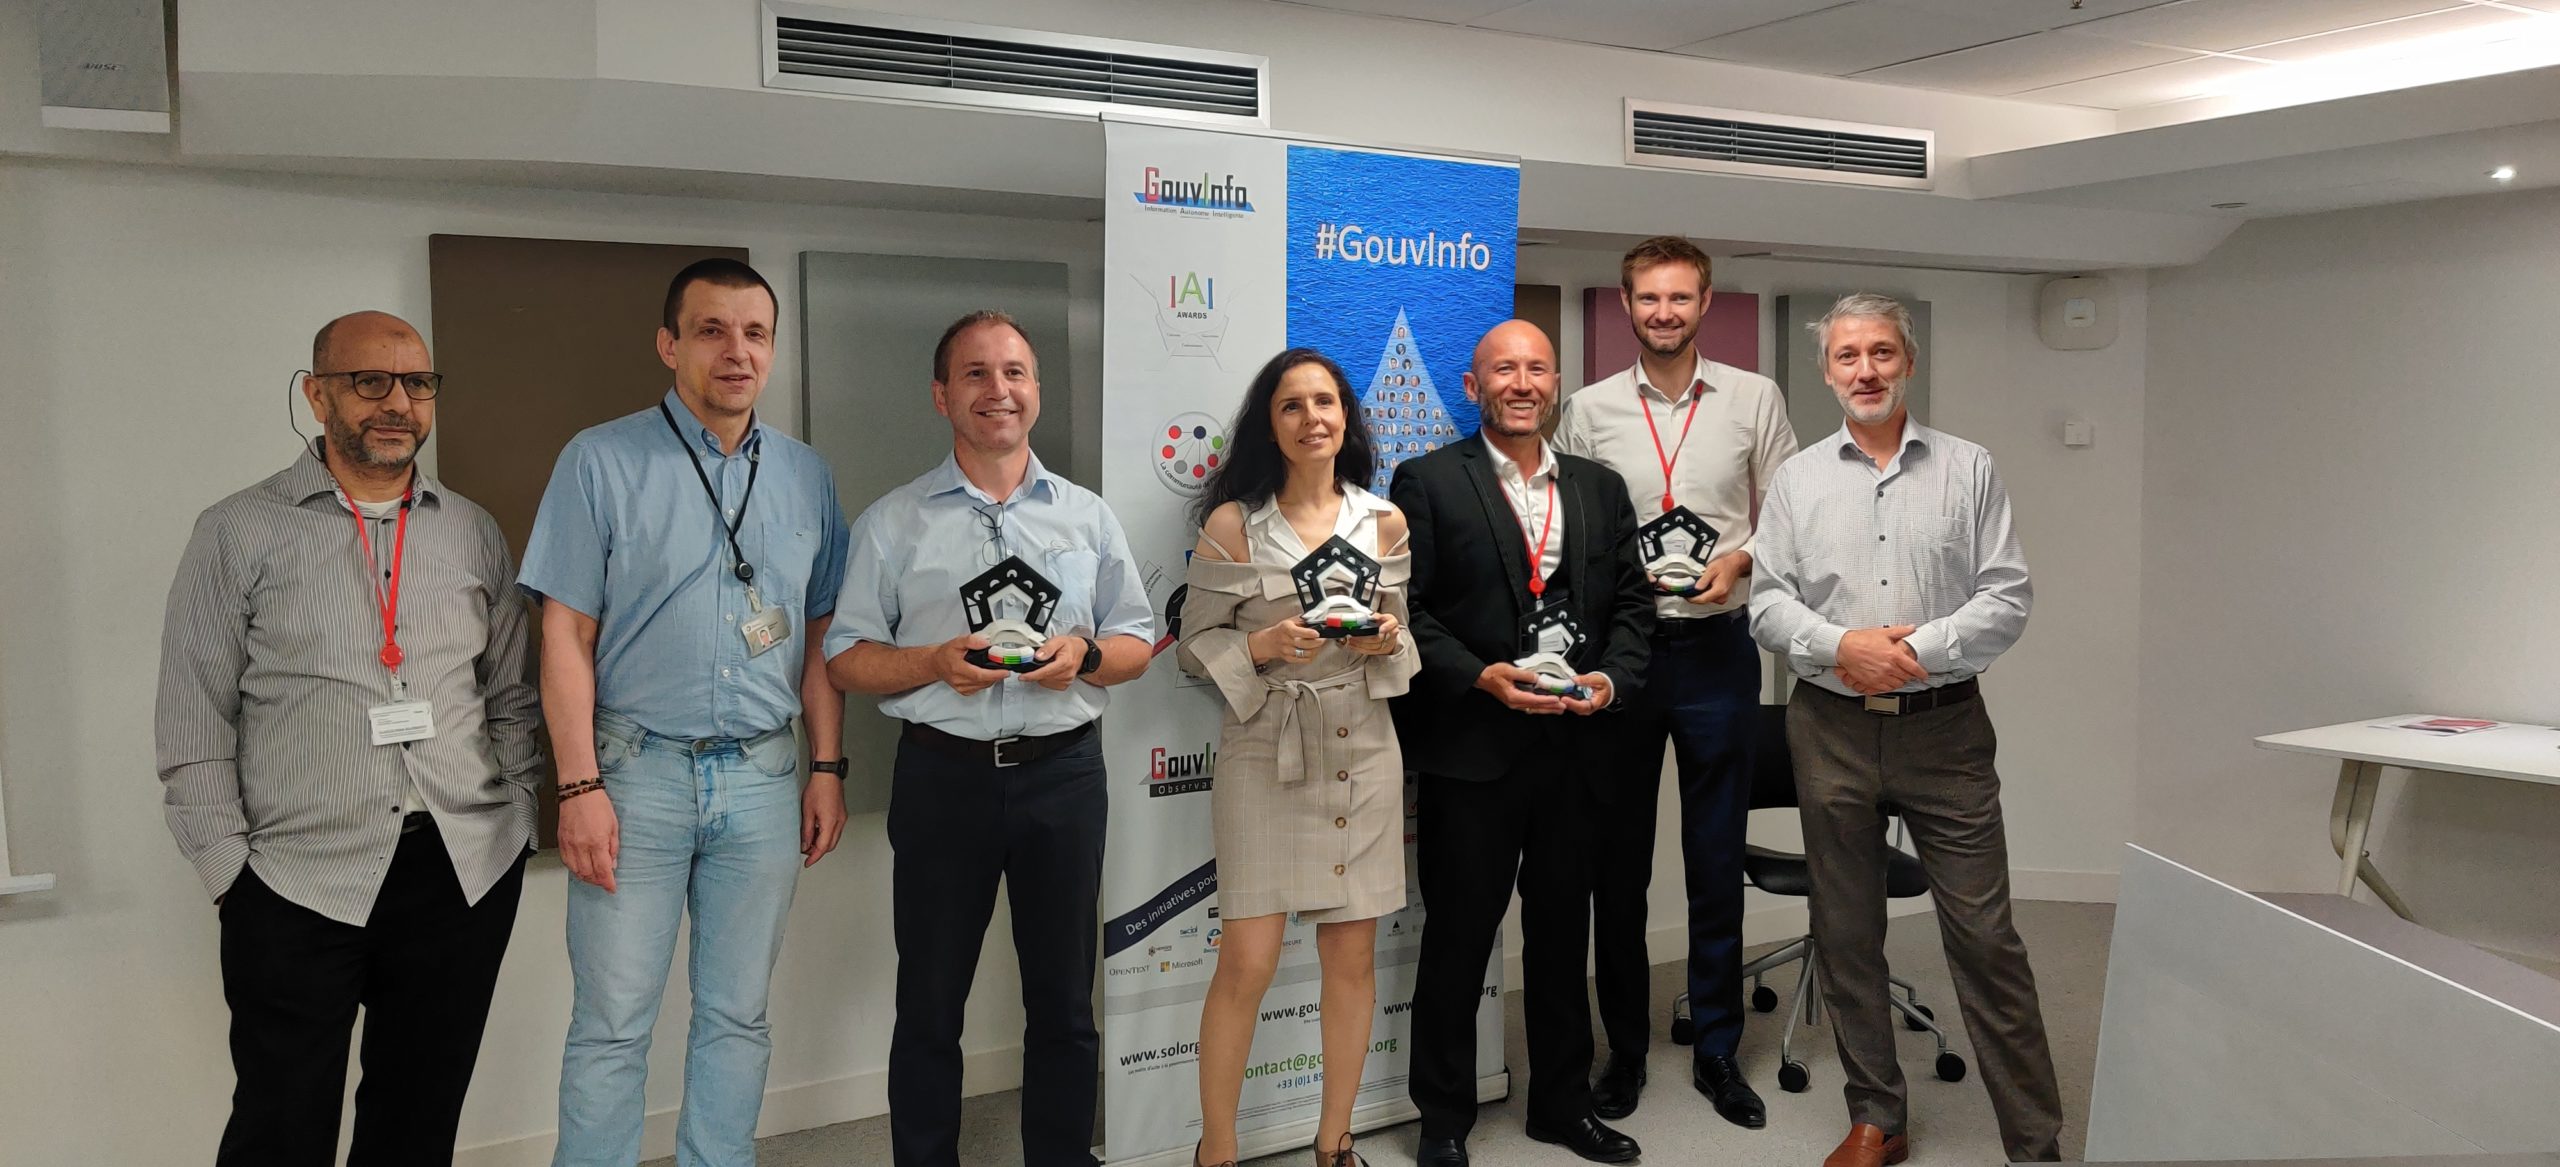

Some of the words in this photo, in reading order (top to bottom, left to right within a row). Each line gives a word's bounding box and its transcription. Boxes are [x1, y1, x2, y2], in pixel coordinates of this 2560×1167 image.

[1145, 166, 1247, 208] GouvInfo
[1144, 205, 1177, 214] Information
[1316, 222, 1492, 272] #GouvInfo
[1170, 271, 1214, 310] IAI
[1176, 311, 1208, 320] AWARDS
[1125, 919, 1148, 936] Des
[1148, 886, 1197, 923] initiatives
[1172, 958, 1203, 970] Microsoft
[1277, 1079, 1293, 1090] +33
